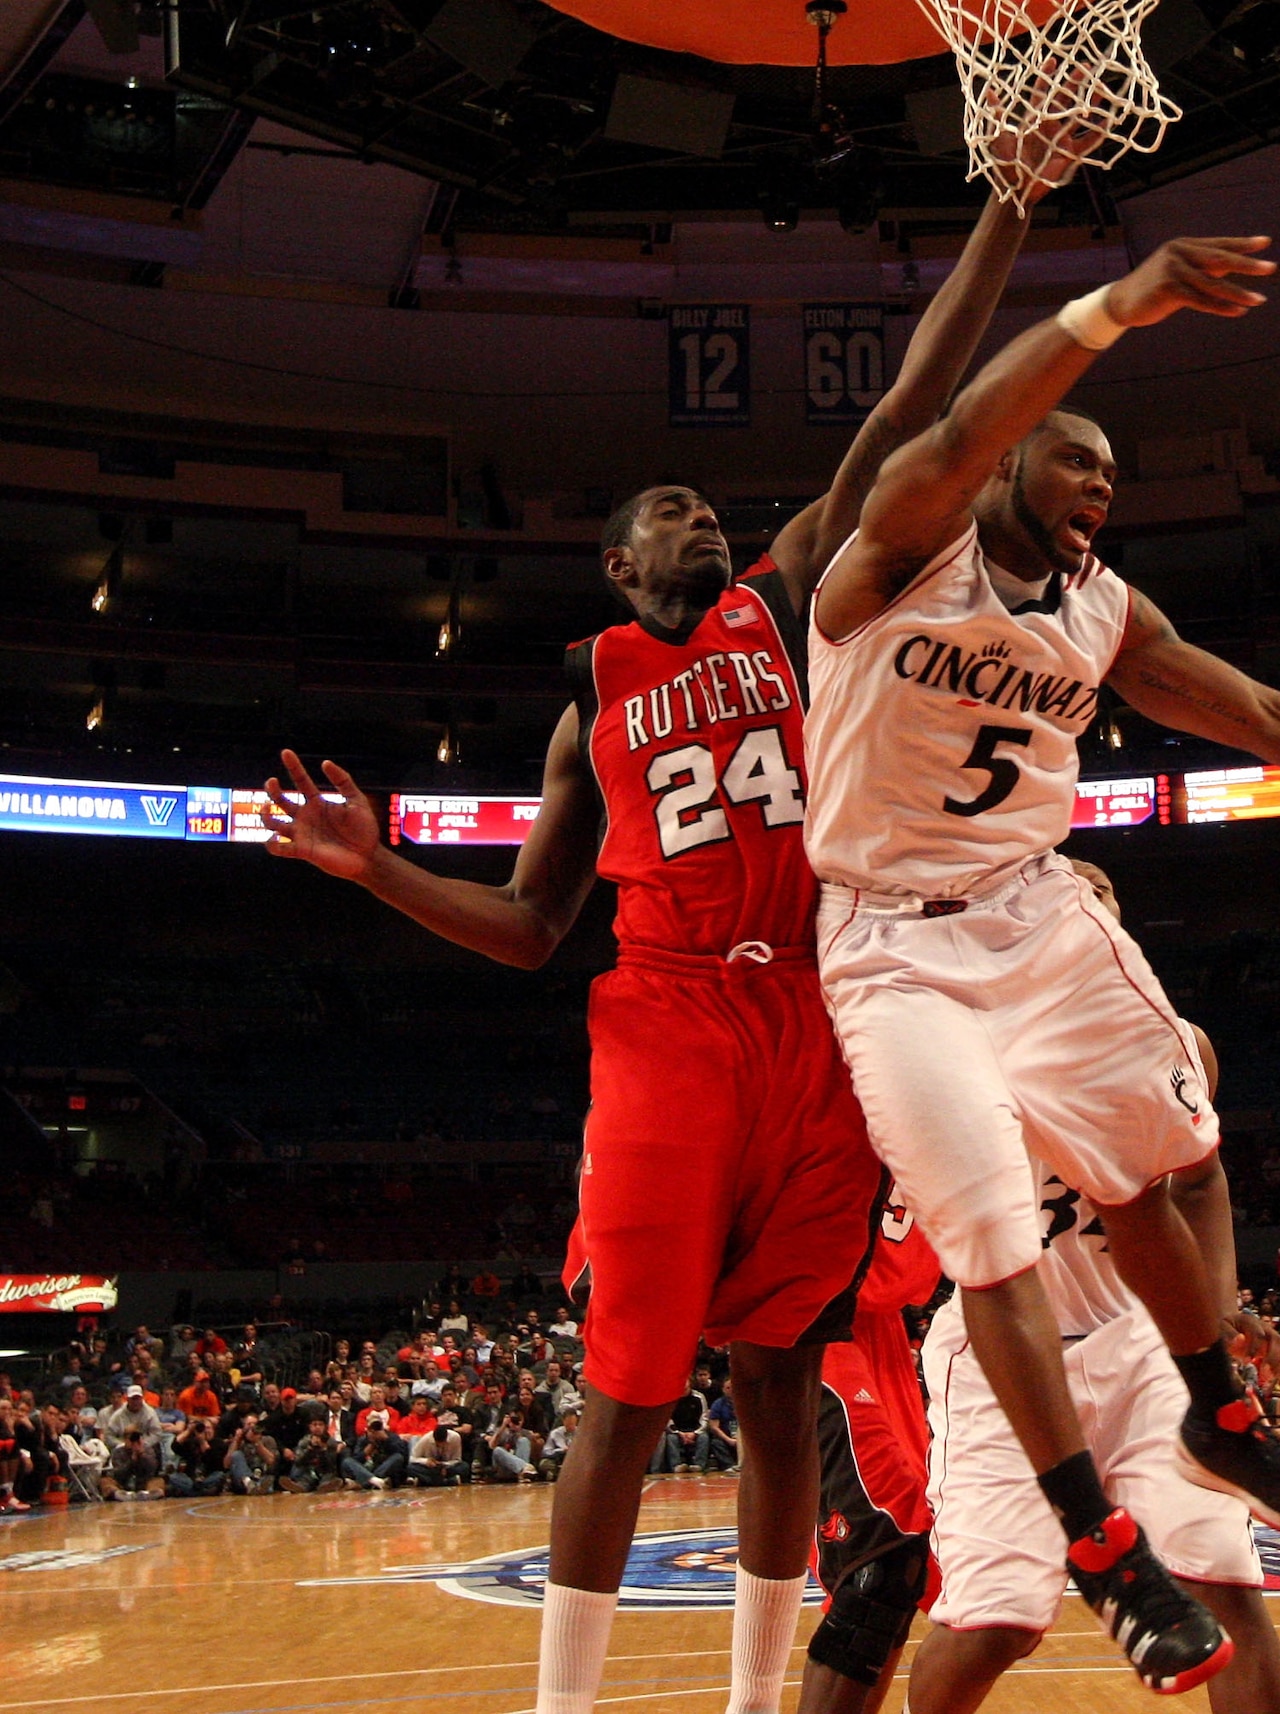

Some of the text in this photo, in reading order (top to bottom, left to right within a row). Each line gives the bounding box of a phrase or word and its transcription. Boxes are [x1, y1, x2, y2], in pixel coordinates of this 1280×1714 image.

[804, 307, 845, 328] ELTON
[678, 331, 740, 409] 12
[805, 330, 884, 408] 60
[0, 792, 127, 819] VILLANOVA
[645, 724, 805, 863] 24
[942, 724, 1033, 817] 5
